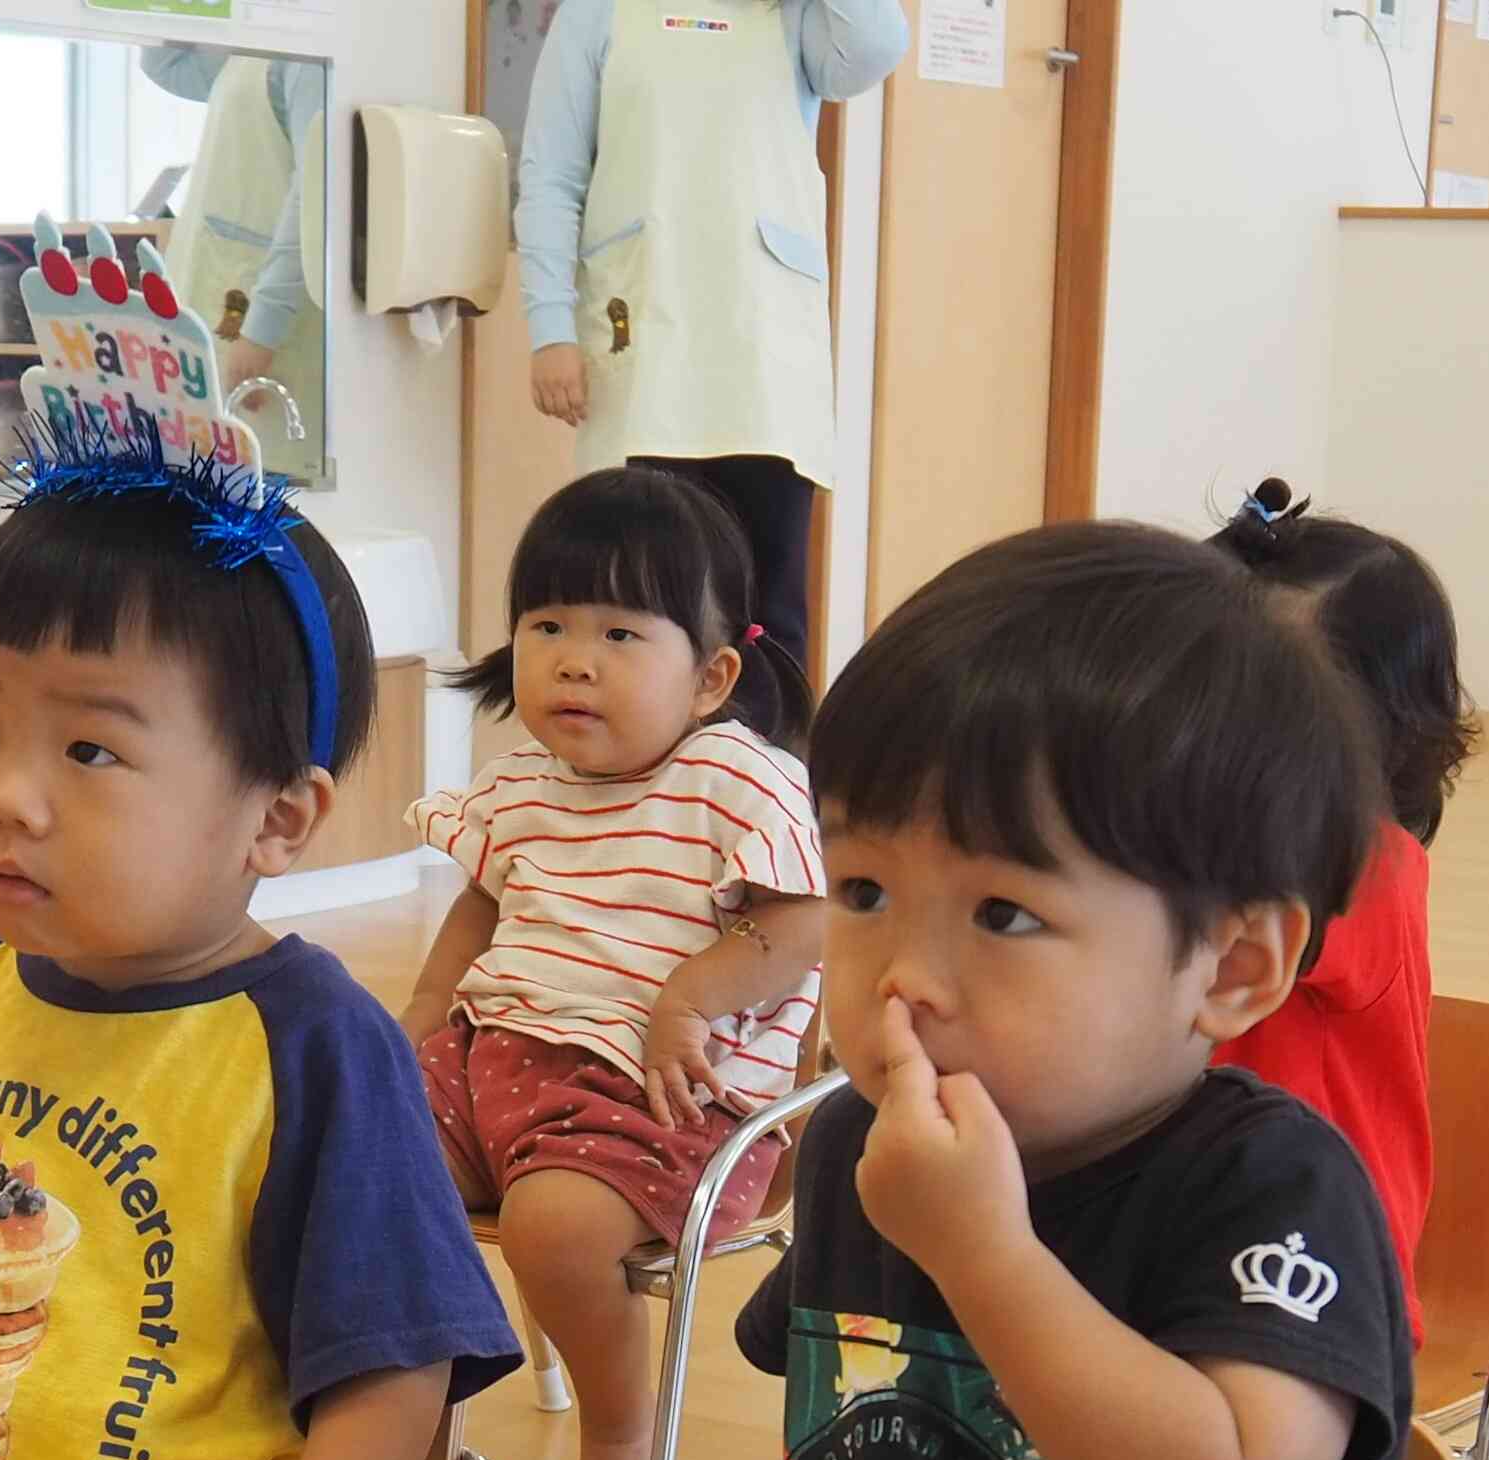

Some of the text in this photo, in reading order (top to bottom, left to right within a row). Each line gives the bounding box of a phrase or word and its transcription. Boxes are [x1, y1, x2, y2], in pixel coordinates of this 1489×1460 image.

[50, 319, 206, 399] Happy
[57, 1096, 178, 1349] different
[843, 1416, 905, 1460] YOUR
